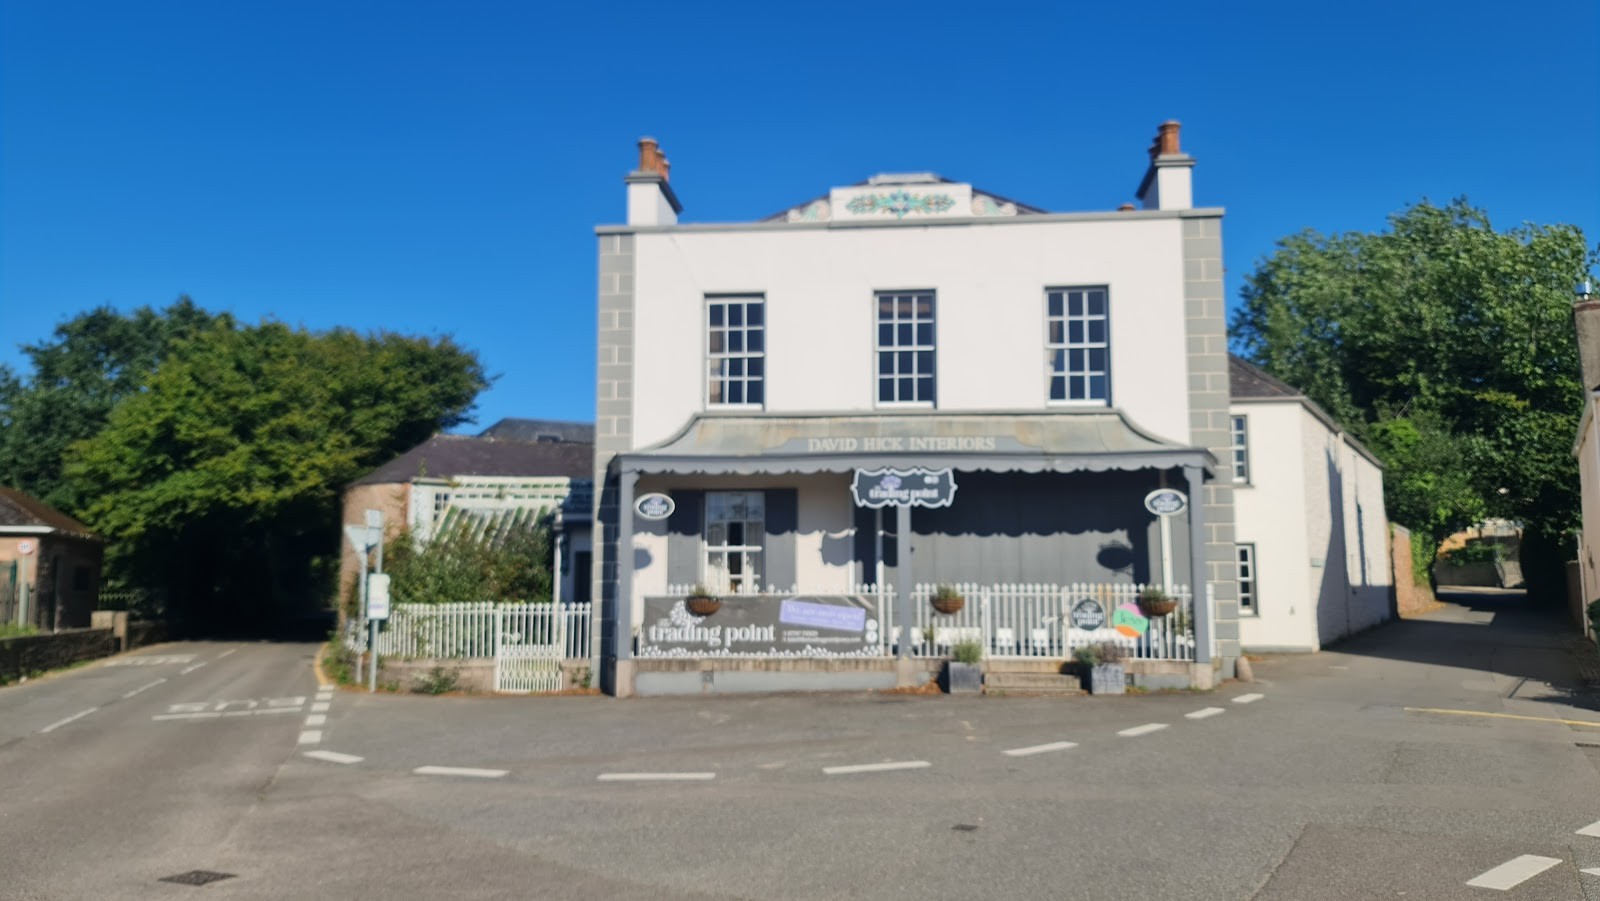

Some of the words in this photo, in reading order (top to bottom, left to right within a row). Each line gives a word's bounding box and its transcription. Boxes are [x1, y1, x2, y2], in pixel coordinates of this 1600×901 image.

[808, 438, 858, 451] DAVID
[863, 437, 903, 450] HICK
[909, 437, 996, 450] INTERIORS
[648, 623, 721, 647] trading
[725, 623, 776, 647] point
